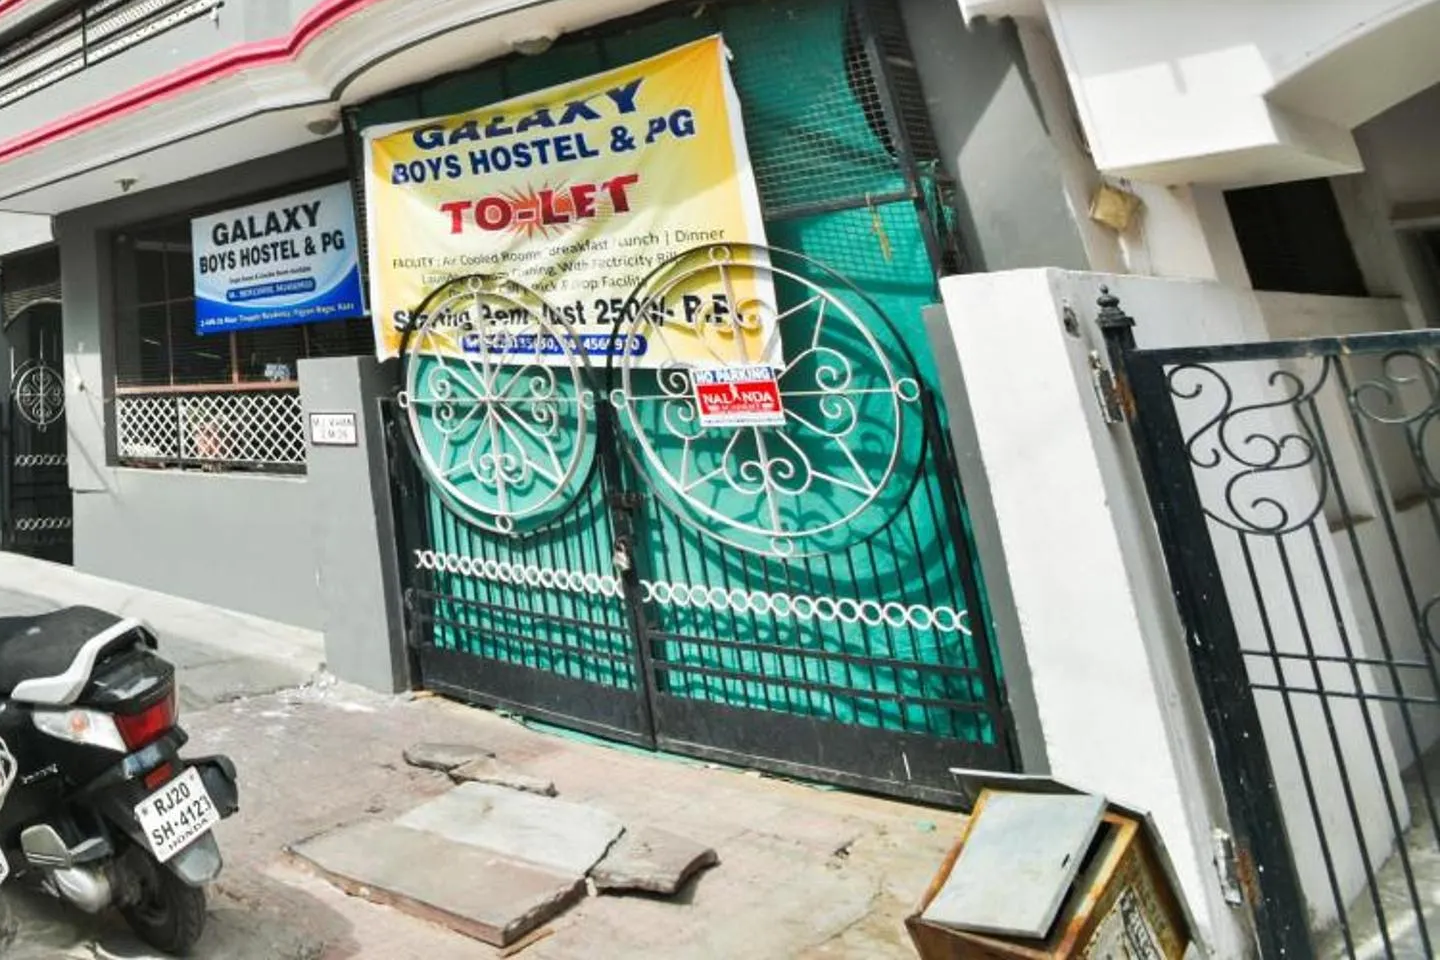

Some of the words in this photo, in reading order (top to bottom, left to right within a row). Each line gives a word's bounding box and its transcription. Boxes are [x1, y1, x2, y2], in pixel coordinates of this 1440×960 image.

[391, 153, 462, 185] BOYS
[468, 132, 600, 176] HOSTEL
[609, 125, 637, 153] &
[645, 108, 696, 144] PG
[212, 200, 322, 247] GALAXY
[440, 173, 639, 235] TO-LET
[199, 249, 237, 275] BOYS
[239, 239, 300, 268] HOSTEL
[304, 235, 317, 257] &
[320, 229, 346, 254] PG
[459, 253, 499, 267] Cooled
[675, 229, 726, 244] Dinner
[153, 782, 191, 817] RJ20
